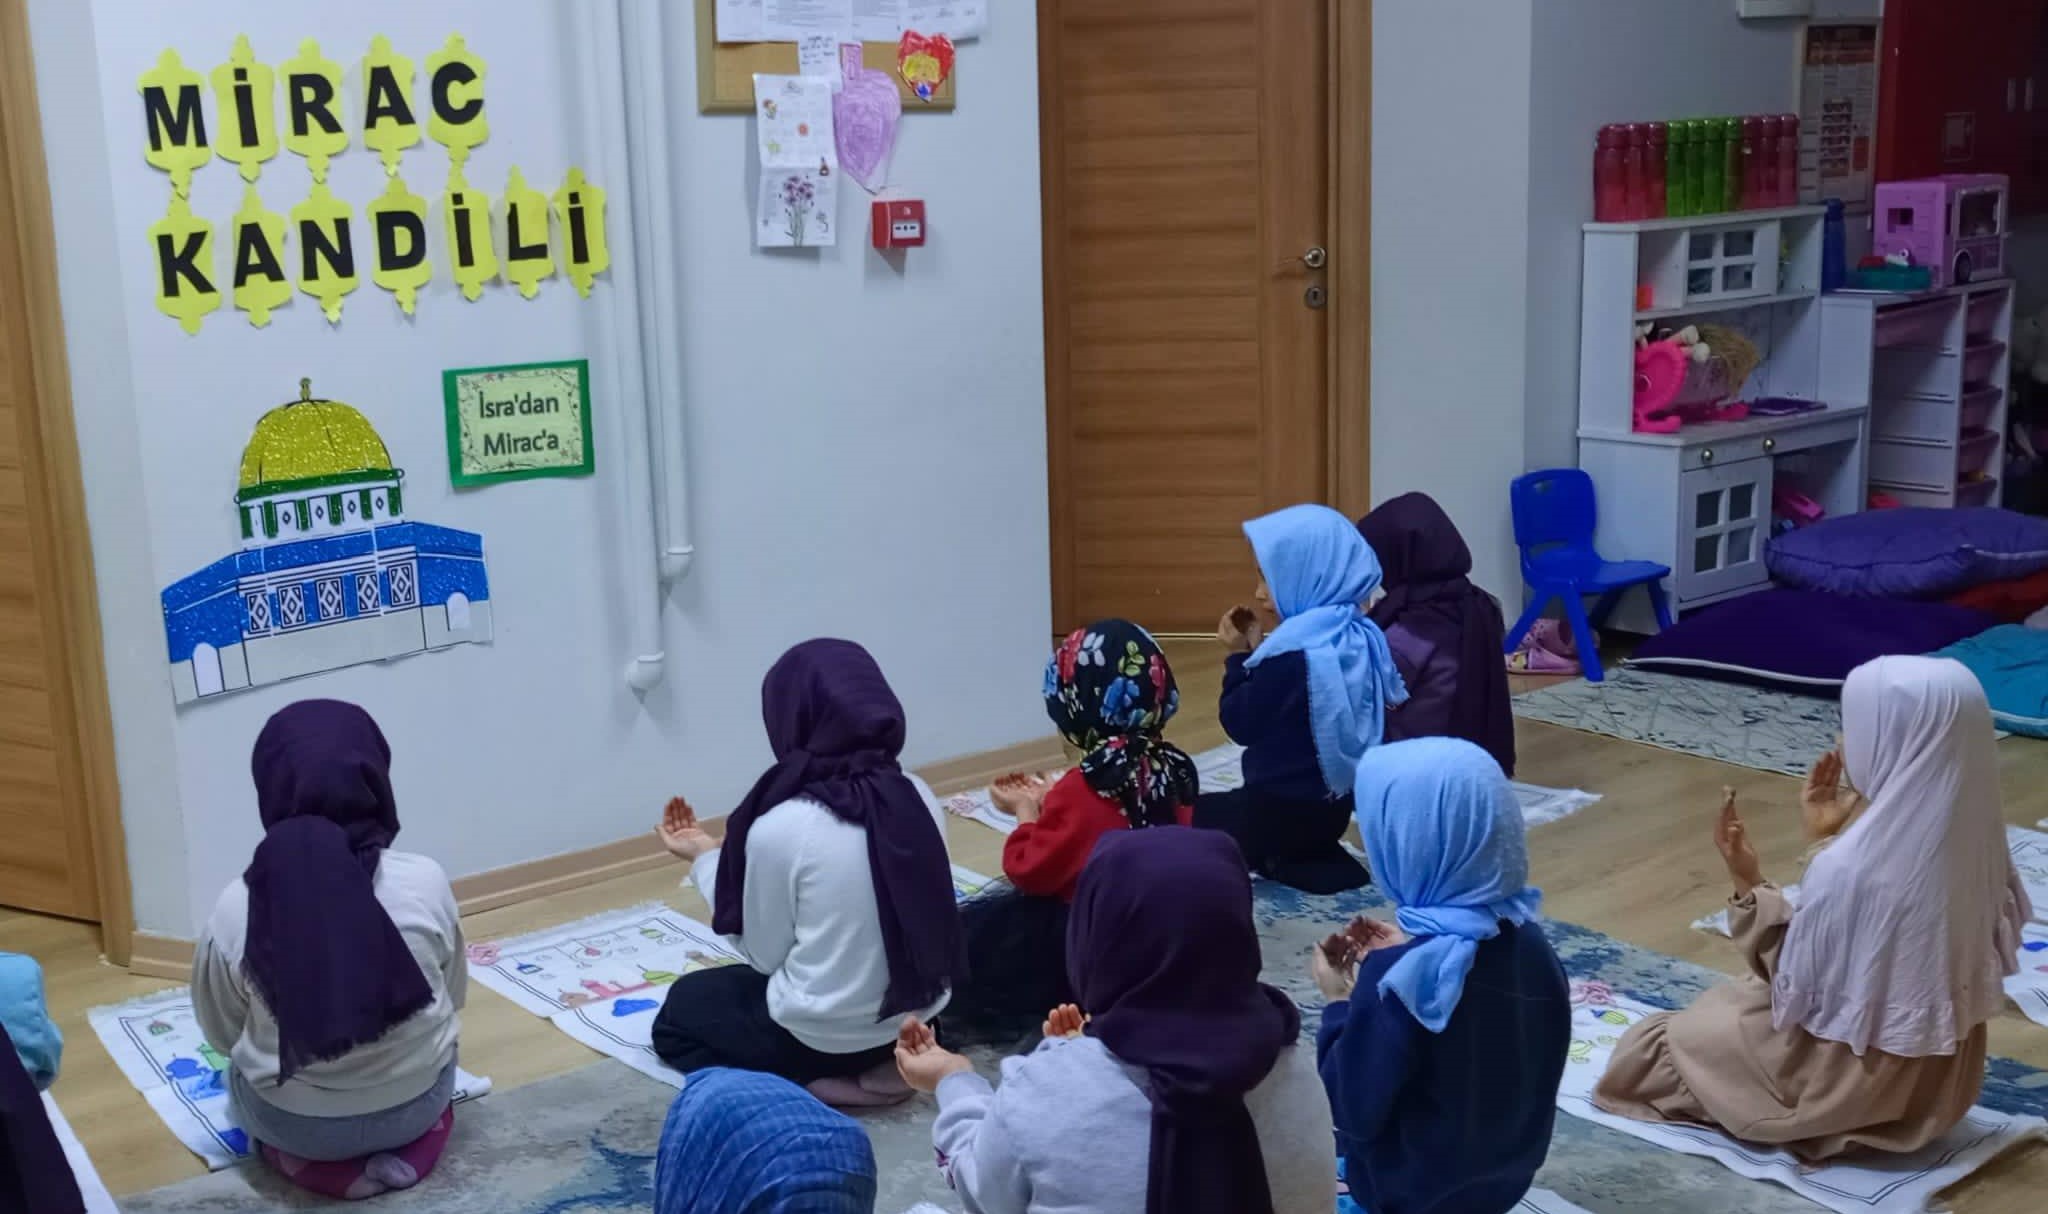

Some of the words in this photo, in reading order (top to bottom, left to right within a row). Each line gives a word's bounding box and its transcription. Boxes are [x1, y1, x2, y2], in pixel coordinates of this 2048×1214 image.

[143, 61, 484, 151] MİRAC
[157, 191, 589, 297] KANDİLİ
[479, 390, 559, 419] İsra'dan
[483, 429, 559, 457] Mirac'a
